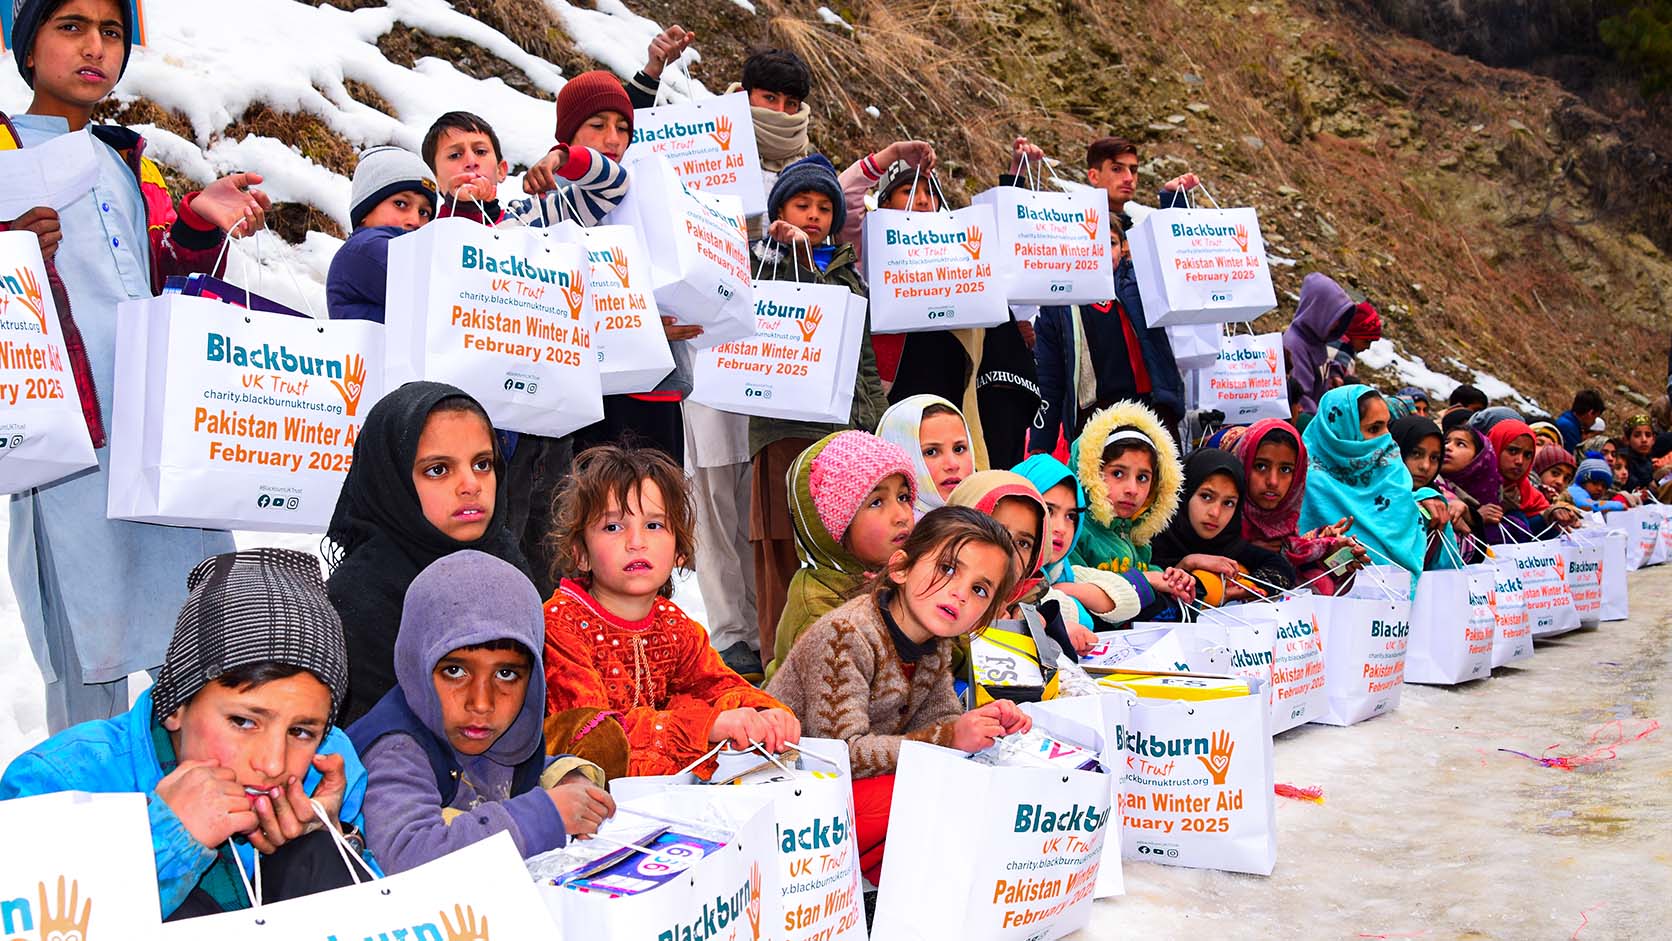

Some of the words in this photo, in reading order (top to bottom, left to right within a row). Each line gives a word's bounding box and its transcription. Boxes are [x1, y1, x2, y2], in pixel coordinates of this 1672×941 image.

[631, 121, 716, 144] Blackburn
[683, 159, 722, 175] Winter
[726, 153, 744, 169] Aid
[705, 172, 736, 187] 2025
[1017, 204, 1084, 222] Blackburn
[686, 219, 722, 249] Pakistan
[886, 229, 966, 245] Blackburn
[1171, 223, 1236, 237] Blackburn
[697, 242, 734, 275] February
[1015, 243, 1057, 256] Pakistan
[1060, 243, 1089, 256] Winter
[1092, 243, 1104, 256] Aid
[462, 245, 569, 288] Blackburn
[1024, 260, 1072, 272] February
[1075, 260, 1098, 270] 2025
[1175, 258, 1214, 270] Pakistan
[1215, 256, 1243, 268] Winter
[1246, 255, 1259, 267] Aid
[884, 270, 933, 285] Pakistan
[936, 267, 972, 280] Winter
[976, 264, 991, 277] Aid
[1186, 272, 1229, 282] February
[1232, 270, 1255, 280] 2025
[491, 279, 512, 293] UK
[516, 280, 545, 300] Trust
[895, 287, 951, 298] February
[955, 282, 985, 294] 2025
[459, 291, 568, 318] charity.blackburnuktrust.org
[592, 293, 625, 312] inter
[629, 293, 647, 310] Aid
[452, 304, 521, 335] Pakistan
[526, 315, 568, 344] Winter
[571, 326, 590, 349] Aid
[606, 315, 642, 331] 2025
[207, 332, 343, 379] Blackburn
[464, 334, 541, 363] February
[546, 346, 581, 367] 2025
[761, 342, 798, 360] Winter
[801, 346, 821, 362] Aid
[717, 357, 772, 375] February
[776, 363, 808, 377] 2025
[25, 378, 64, 399] 2025
[242, 374, 265, 390] UK
[270, 376, 309, 396] Trust
[1210, 378, 1247, 389] Pakistan
[1248, 378, 1270, 388] Winter
[204, 389, 342, 415] charity.blackburnuktrust.org
[1218, 392, 1258, 400] February
[1260, 389, 1279, 398] 2025
[194, 407, 278, 440] Pakistan
[284, 416, 341, 446] Winter
[344, 424, 360, 448] Ai
[209, 441, 303, 472] February
[308, 451, 353, 473] 2025
[1514, 556, 1556, 569] lackburn
[1527, 601, 1551, 609] bruary
[1371, 620, 1409, 638] Blackb
[1274, 667, 1304, 684] akistan
[1139, 758, 1176, 776] Trust
[1152, 793, 1210, 813] Winter
[1216, 789, 1243, 811] Aid
[1123, 816, 1174, 833] ruary
[1181, 817, 1229, 833] 2025
[1043, 837, 1062, 855] UK
[790, 857, 814, 877] UK
[993, 877, 1061, 905] Pakistan
[784, 904, 820, 931] stan
[1003, 902, 1065, 929] February
